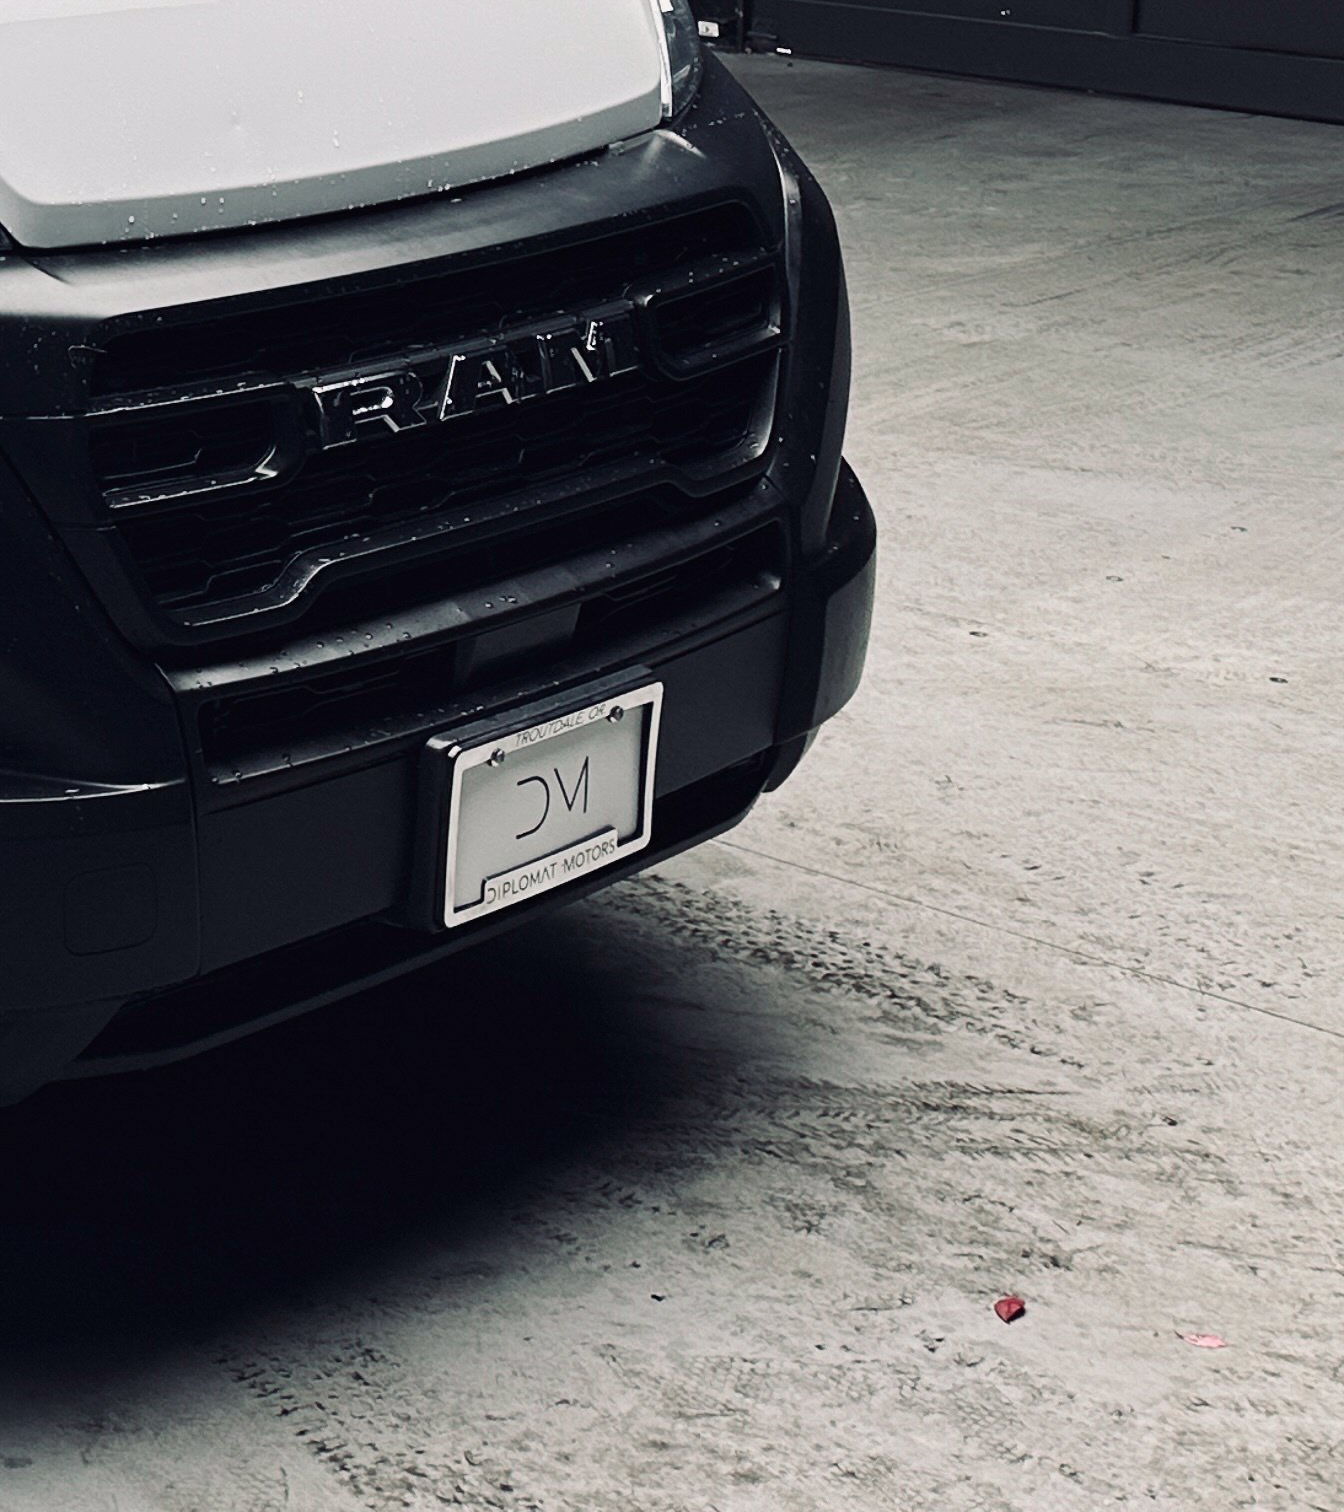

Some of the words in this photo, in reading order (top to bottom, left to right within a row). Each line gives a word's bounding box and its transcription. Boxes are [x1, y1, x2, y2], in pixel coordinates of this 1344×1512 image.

[313, 315, 640, 450] RAM
[515, 711, 585, 748] TROUTDALE
[589, 703, 607, 721] OR
[485, 862, 557, 905] DIPLOMAT
[560, 838, 616, 874] MOTORS
